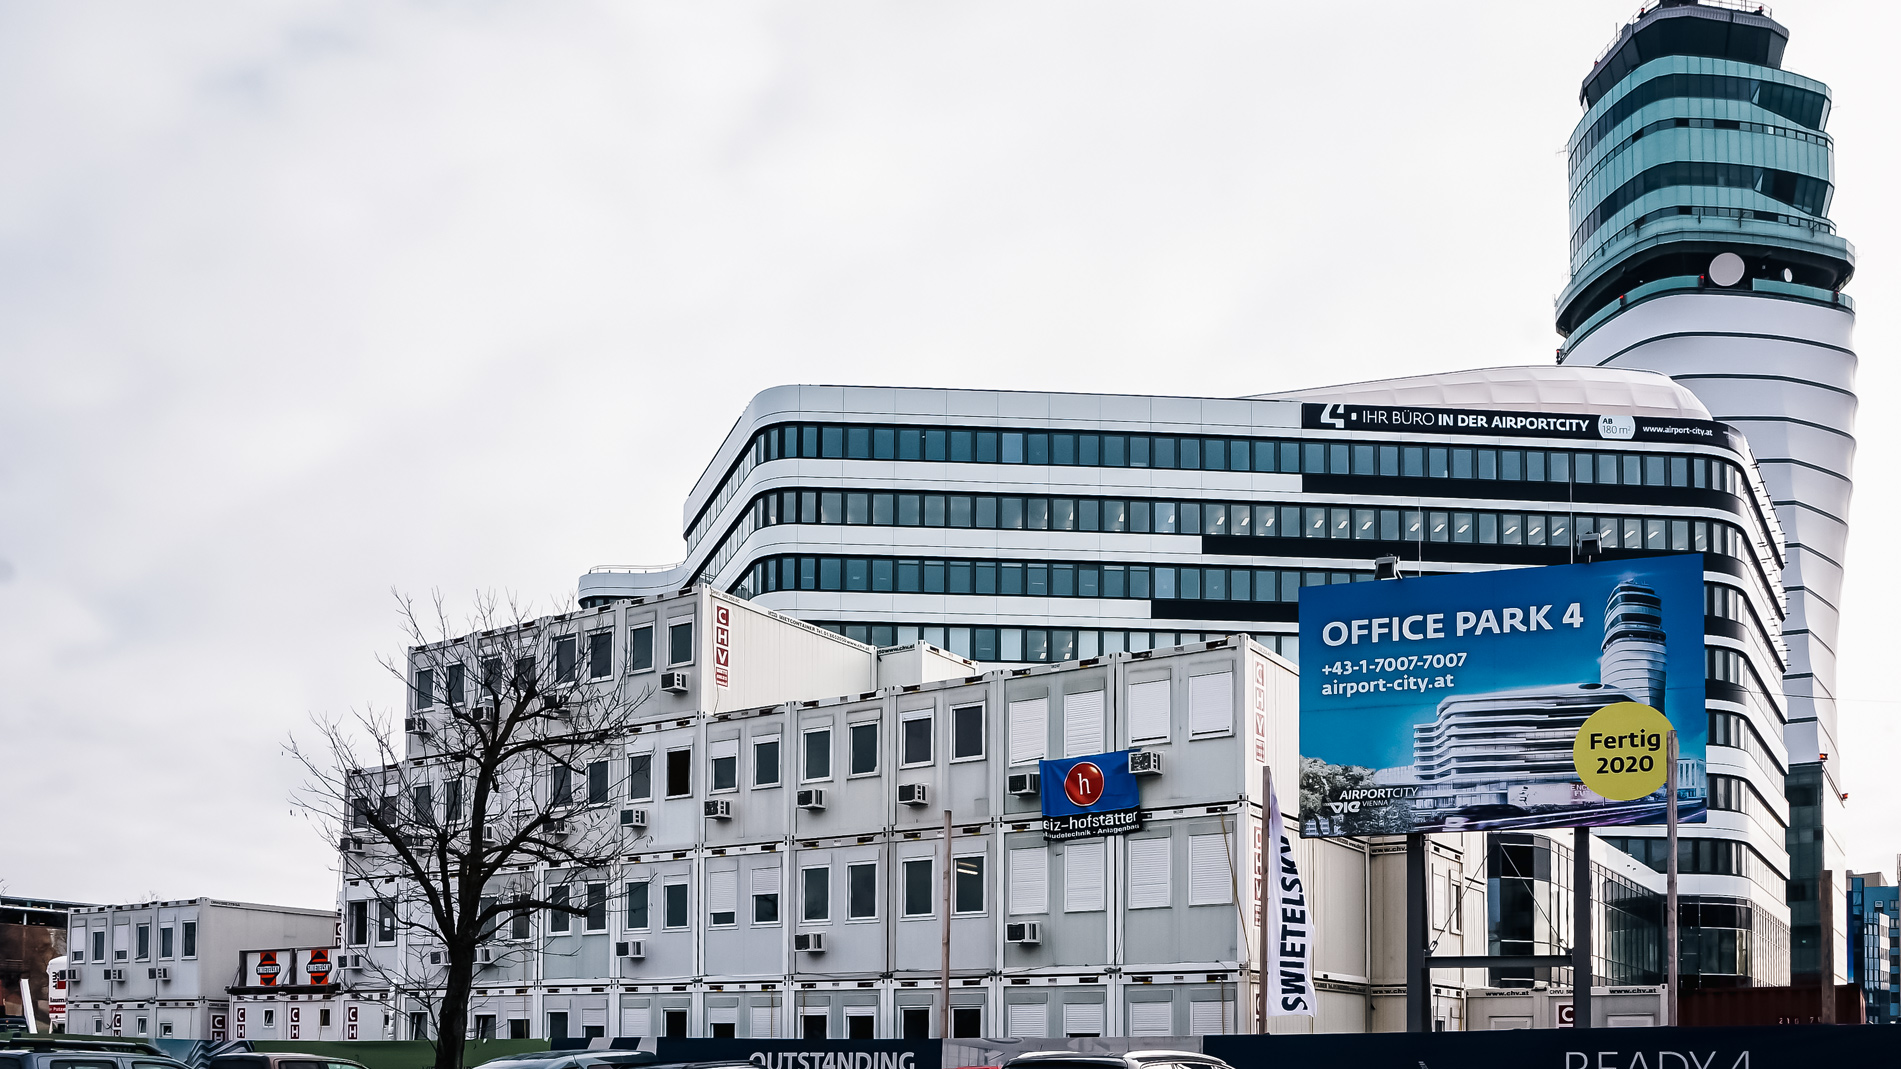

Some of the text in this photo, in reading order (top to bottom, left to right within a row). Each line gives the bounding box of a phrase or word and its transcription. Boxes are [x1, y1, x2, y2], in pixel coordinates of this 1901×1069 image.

[1362, 410, 1389, 424] IHR
[1392, 409, 1435, 426] BÜRO
[1438, 413, 1454, 426] IN
[1457, 414, 1488, 428] DER
[1491, 416, 1590, 432] AIRPORTCITY
[1602, 425, 1618, 435] 180
[1642, 424, 1713, 437] www.airport-city.at
[1322, 602, 1584, 647] OFFICE PARK 4
[1321, 652, 1467, 676] +43-1-7007-7007
[1321, 674, 1455, 698] airport-city.at
[1590, 728, 1661, 752] Fertig
[1596, 755, 1654, 774] 2020
[1339, 786, 1420, 801] AIRPORTCITY
[1362, 799, 1389, 807] VIENNA
